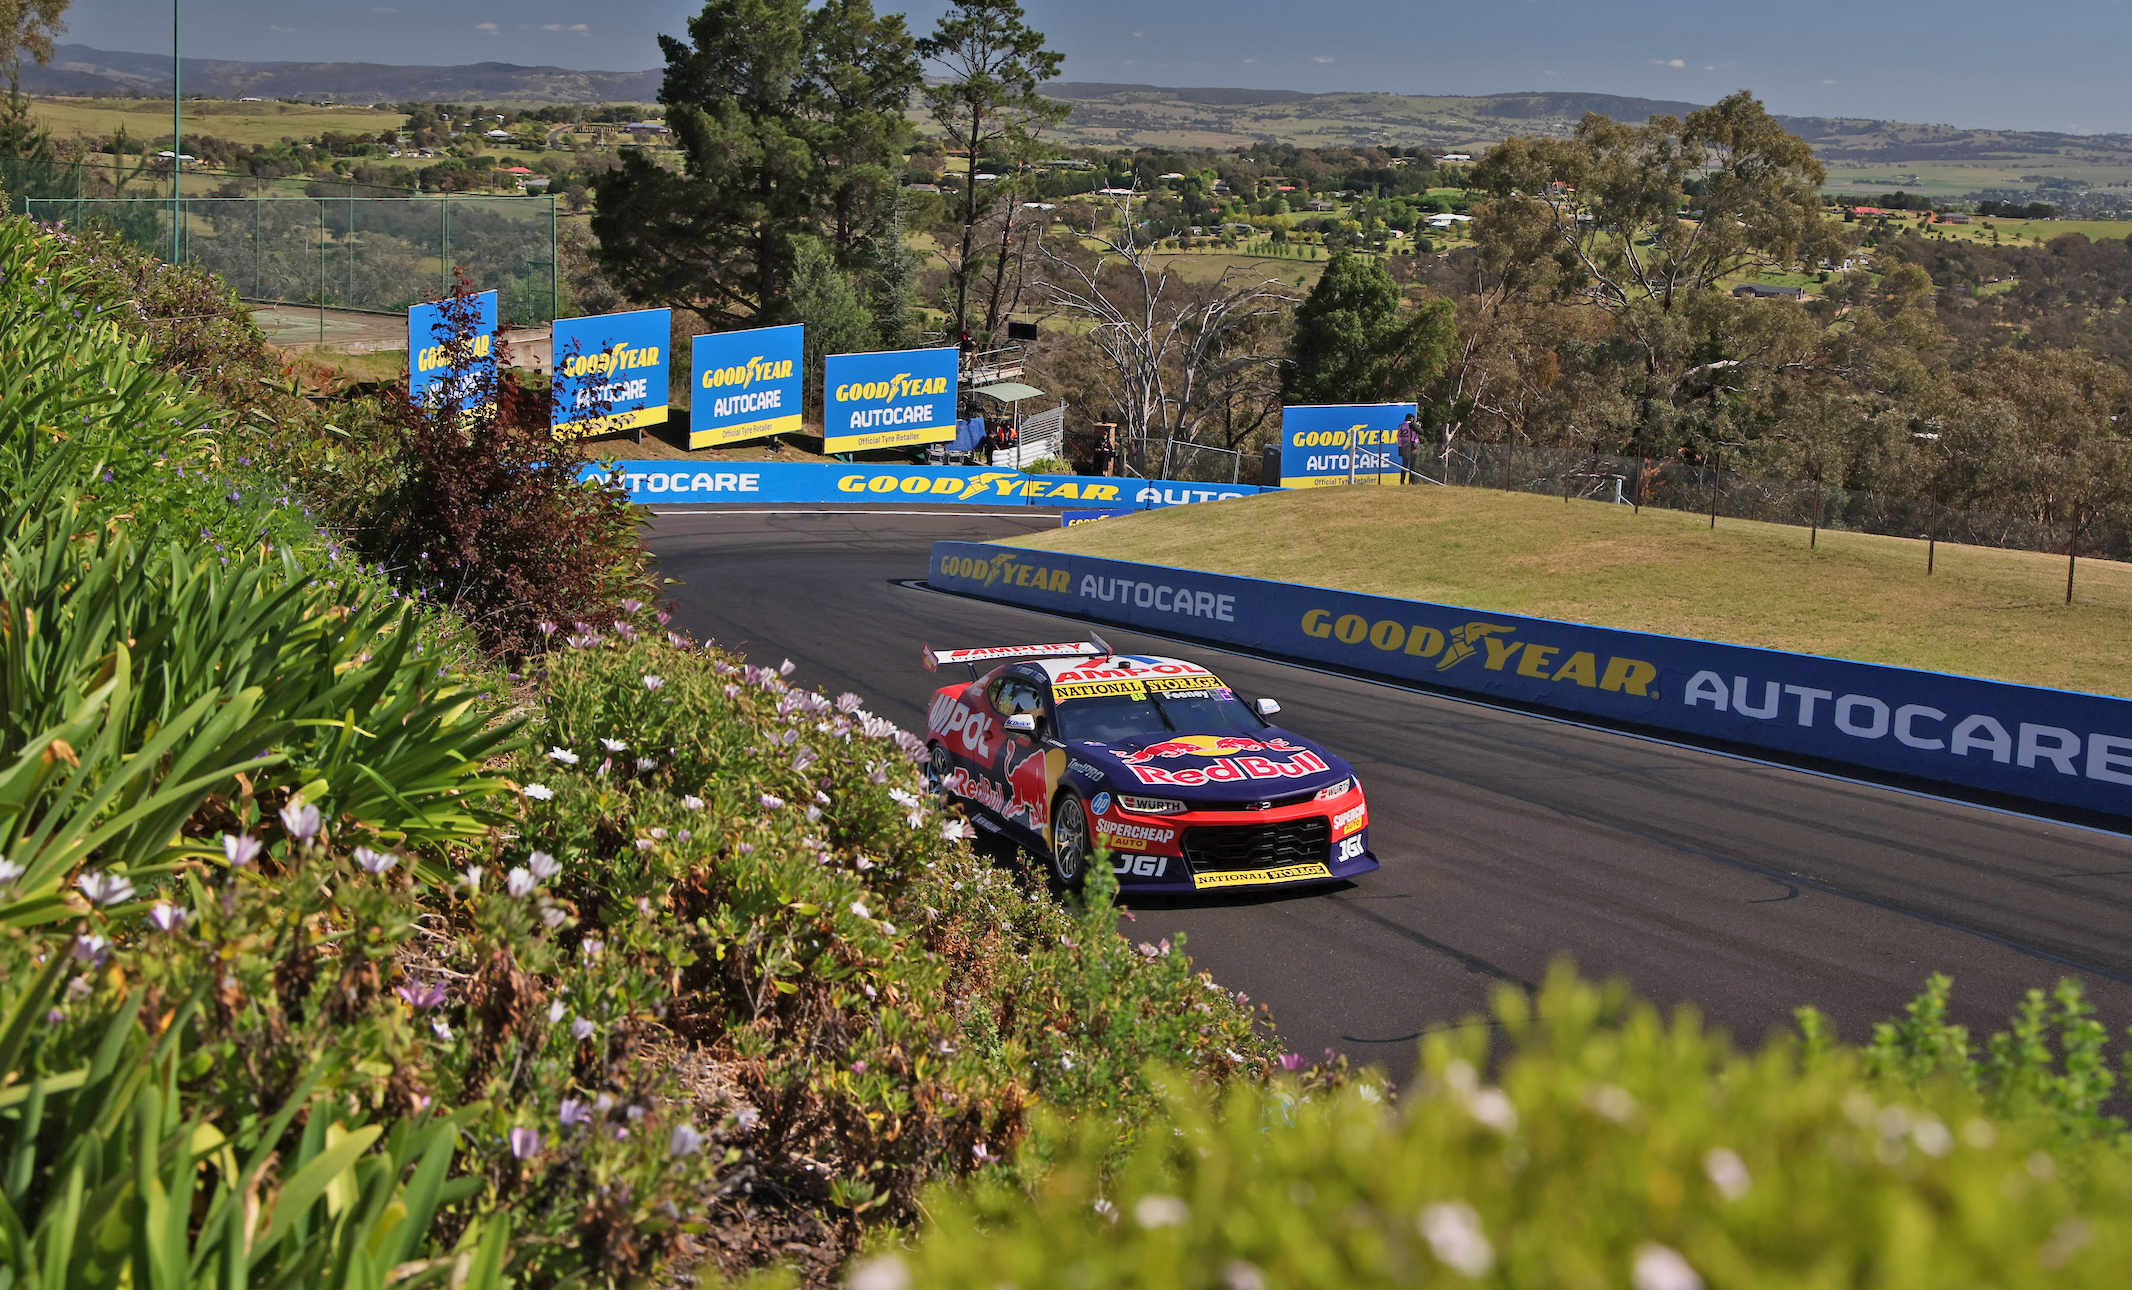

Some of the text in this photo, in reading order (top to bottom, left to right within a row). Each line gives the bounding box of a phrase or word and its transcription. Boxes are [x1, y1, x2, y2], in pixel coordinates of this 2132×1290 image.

[564, 342, 659, 378] GOODYEAR
[702, 356, 793, 389] GOODYEAR
[836, 373, 948, 403] GOODYEAR
[714, 389, 781, 417] AUTOCARE
[850, 404, 933, 428] AUTOCARE
[722, 423, 773, 439] Official Tyre Retailer
[858, 432, 920, 446] Official Tyre Retailer
[1306, 452, 1390, 471] AUTOCARE
[837, 472, 1120, 501] GOODYEAR
[1314, 478, 1337, 486] Official
[940, 553, 1236, 622] GOODYEAR AUTOCARE
[972, 643, 1081, 655] AMPLIFY
[1055, 665, 1208, 683] AMPOL
[1056, 676, 1221, 699] NATIONAL STORAGE
[1130, 693, 1148, 702] 88
[1162, 689, 1209, 700] Feeney
[1301, 608, 2132, 786] GOODYEAR AUTOCARE
[1067, 757, 1106, 783] ToolPRO
[1126, 750, 1330, 786] Red Bull
[951, 766, 1005, 814] Red Bull
[1093, 793, 1110, 813] hp
[1096, 818, 1175, 844] SUPERCHEAP
[1115, 837, 1143, 847] AUTO
[1338, 833, 1364, 862] JGI
[1113, 854, 1169, 877] JGI
[1199, 865, 1325, 884] NATIONAL STORAGE
